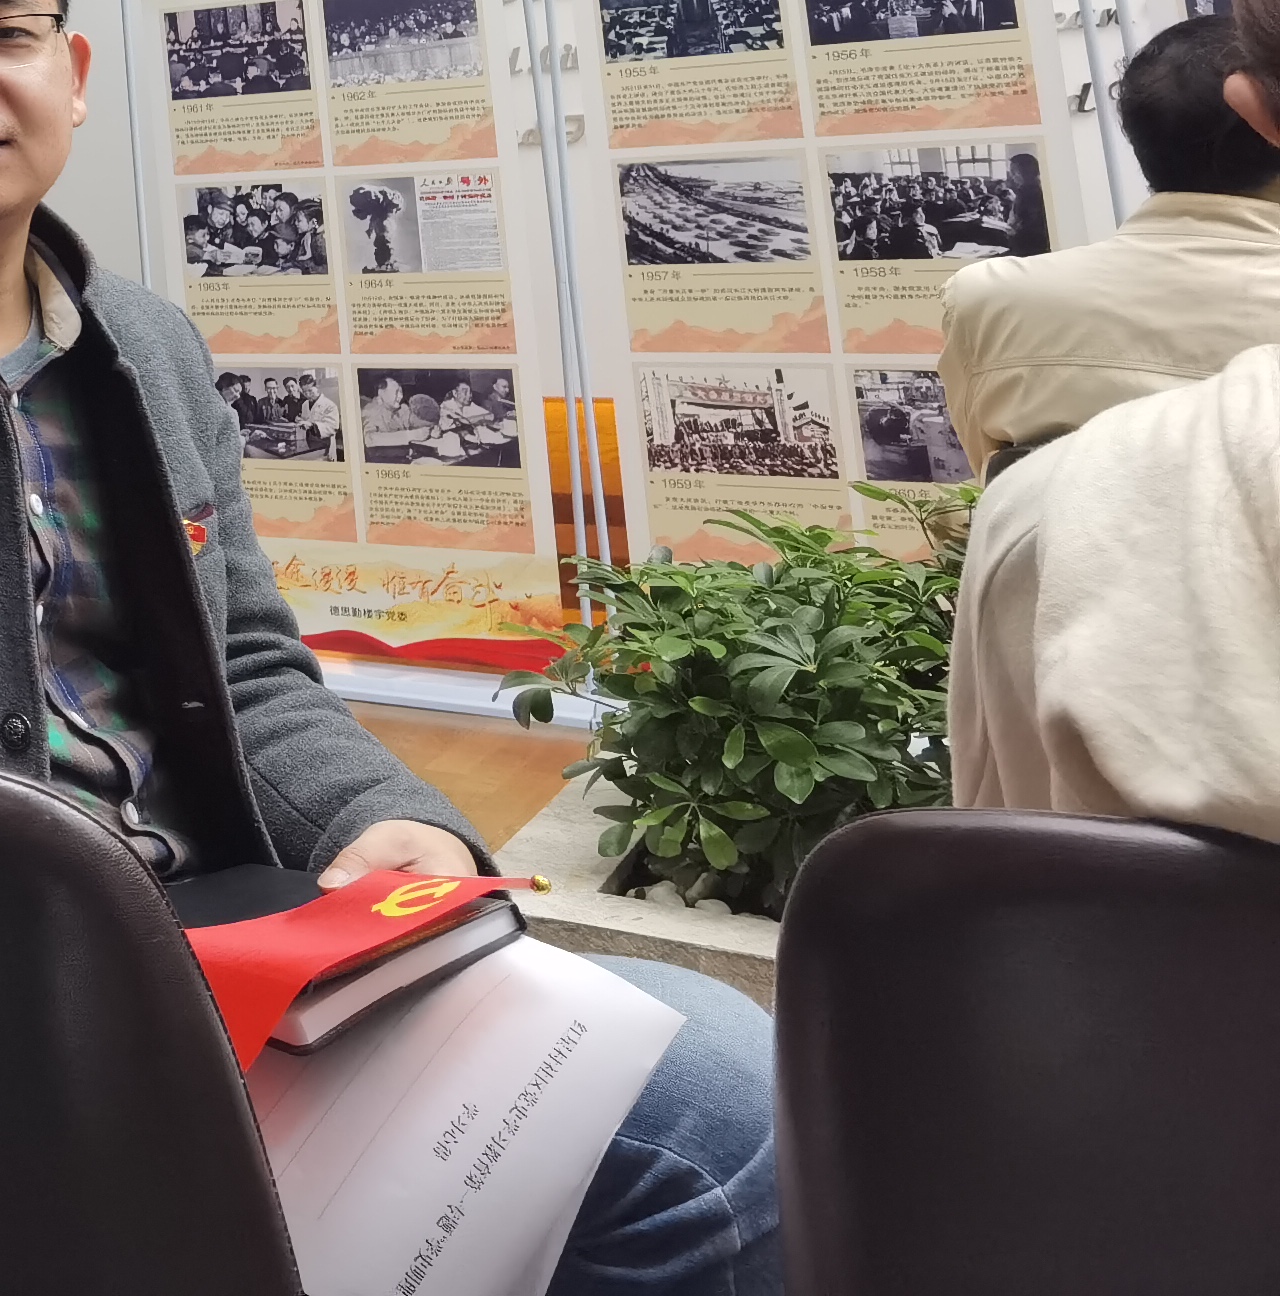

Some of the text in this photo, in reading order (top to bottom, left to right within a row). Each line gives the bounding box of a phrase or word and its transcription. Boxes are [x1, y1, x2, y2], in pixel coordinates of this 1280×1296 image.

[824, 47, 872, 62] 1956年
[618, 65, 660, 79] 1955年
[640, 270, 682, 282] 1957年
[852, 266, 902, 278] 1958年
[272, 553, 367, 594] 途漫漫
[433, 1102, 480, 1162] 学习心得
